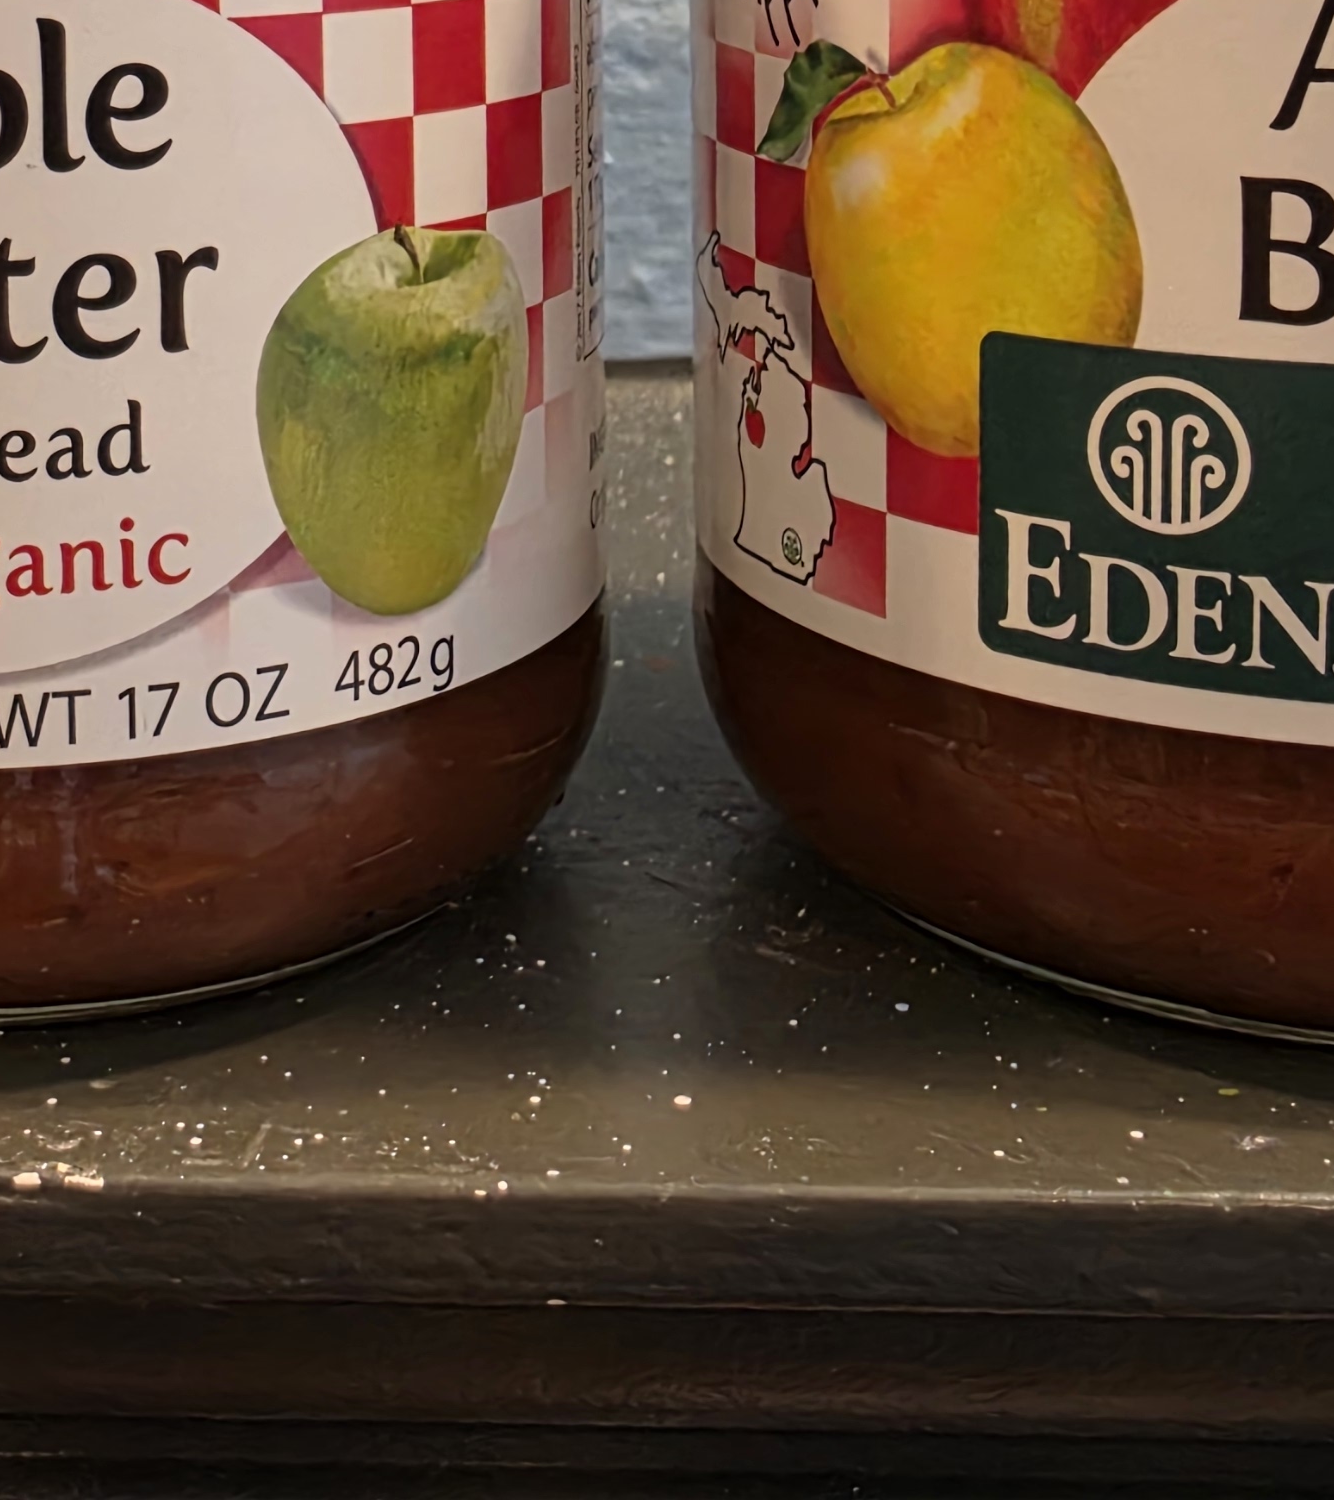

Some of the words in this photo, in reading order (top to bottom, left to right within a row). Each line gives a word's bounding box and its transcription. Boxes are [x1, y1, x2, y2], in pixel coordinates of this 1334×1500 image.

[119, 681, 180, 740] 17
[205, 663, 290, 727] OZ
[334, 633, 456, 702] 482g
